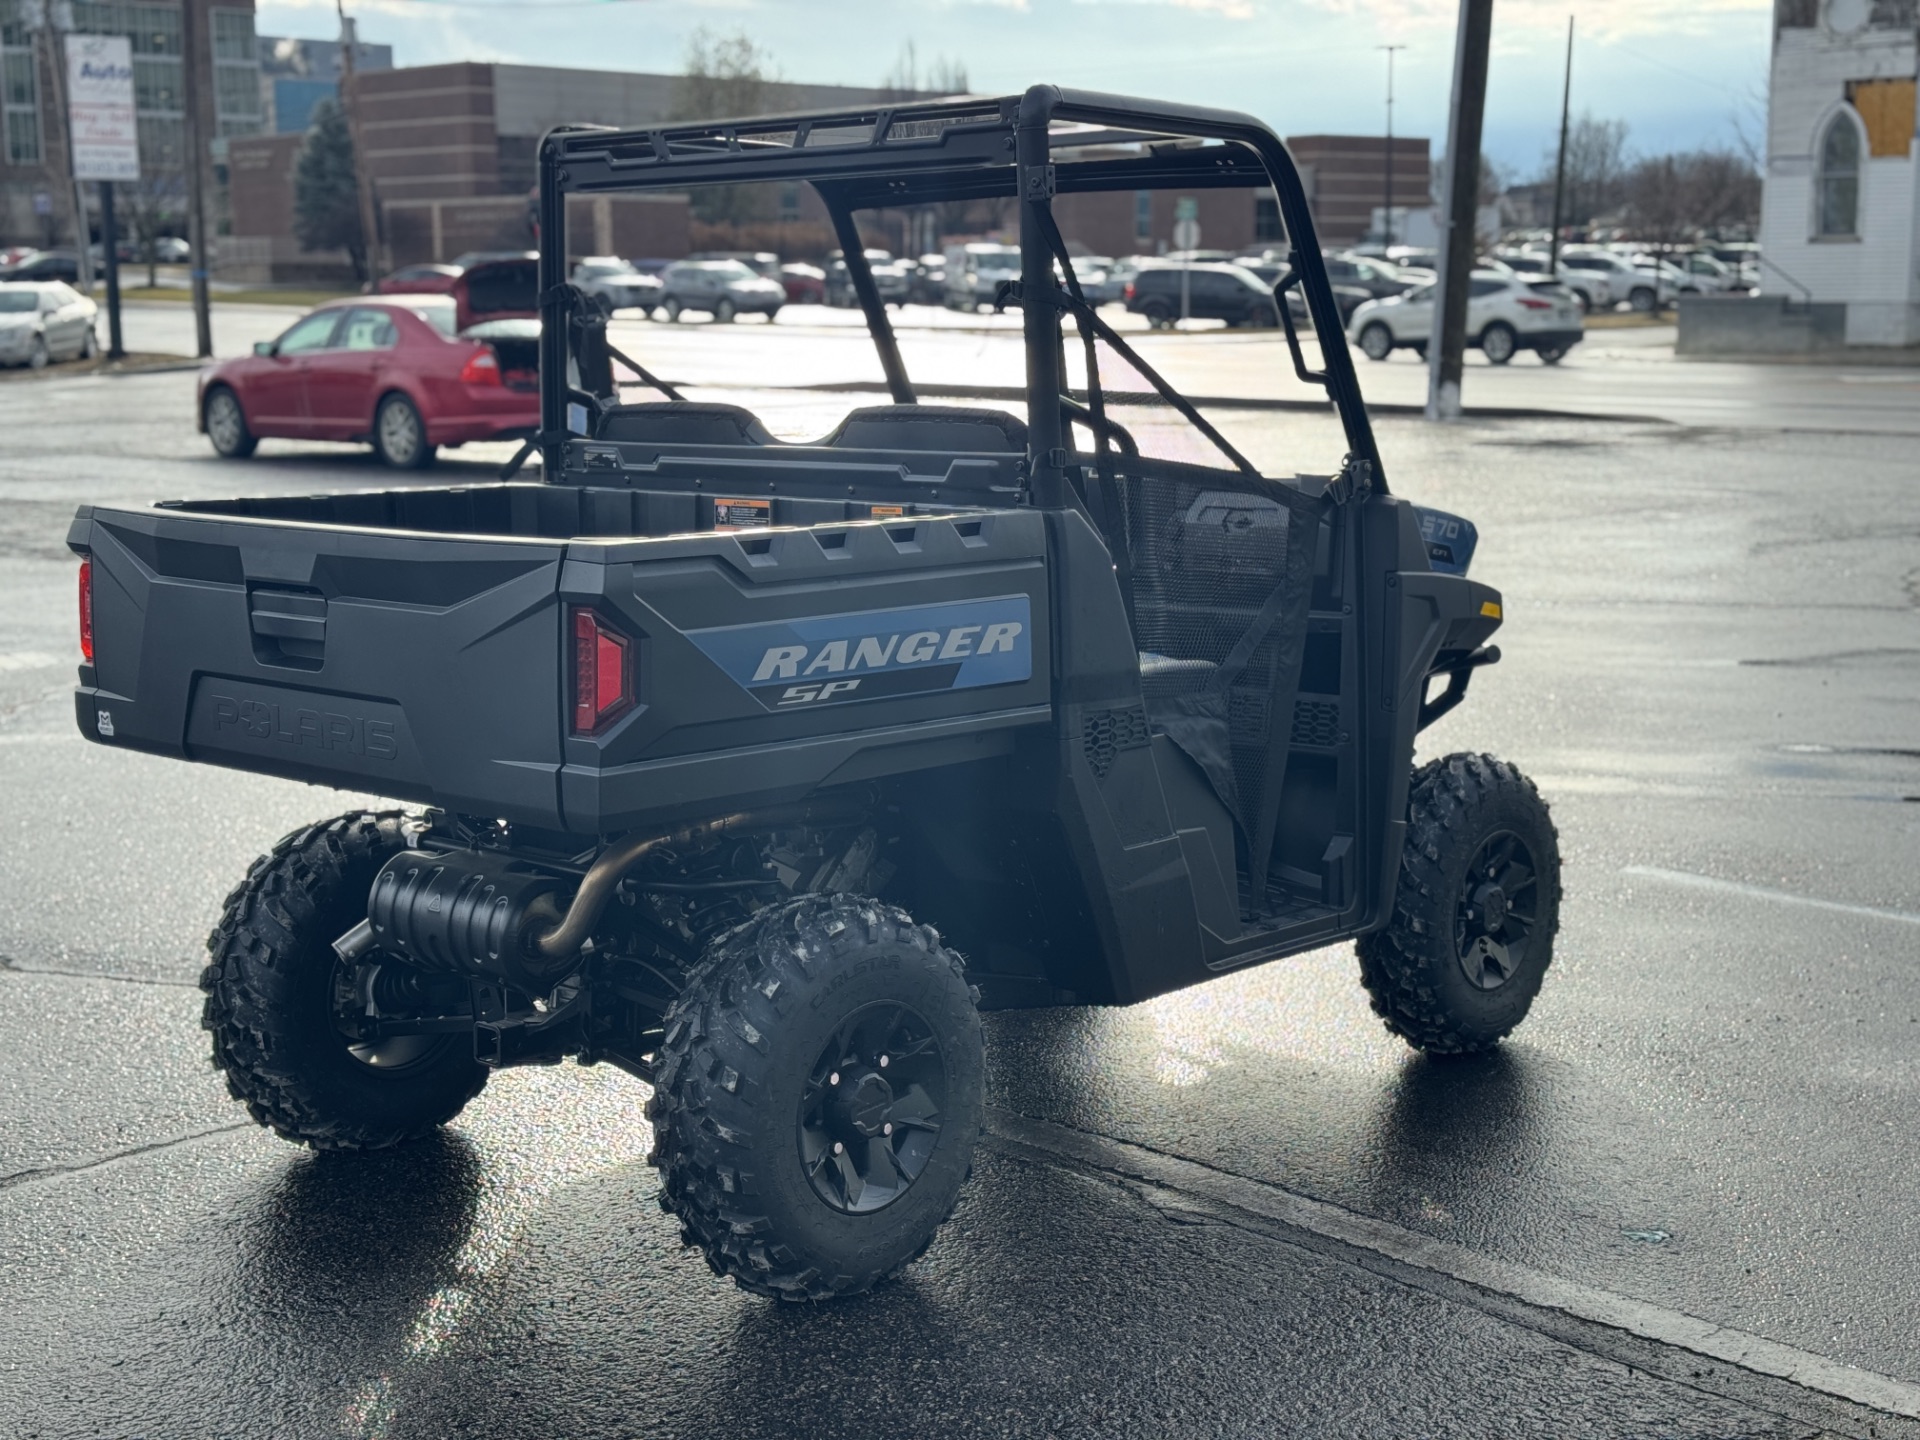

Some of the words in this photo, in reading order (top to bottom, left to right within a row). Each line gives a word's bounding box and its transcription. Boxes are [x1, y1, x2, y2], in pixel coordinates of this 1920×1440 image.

[1421, 515, 1459, 539] 570
[752, 622, 1022, 682] RANGER
[777, 679, 861, 706] SP
[211, 694, 398, 761] POLARIS
